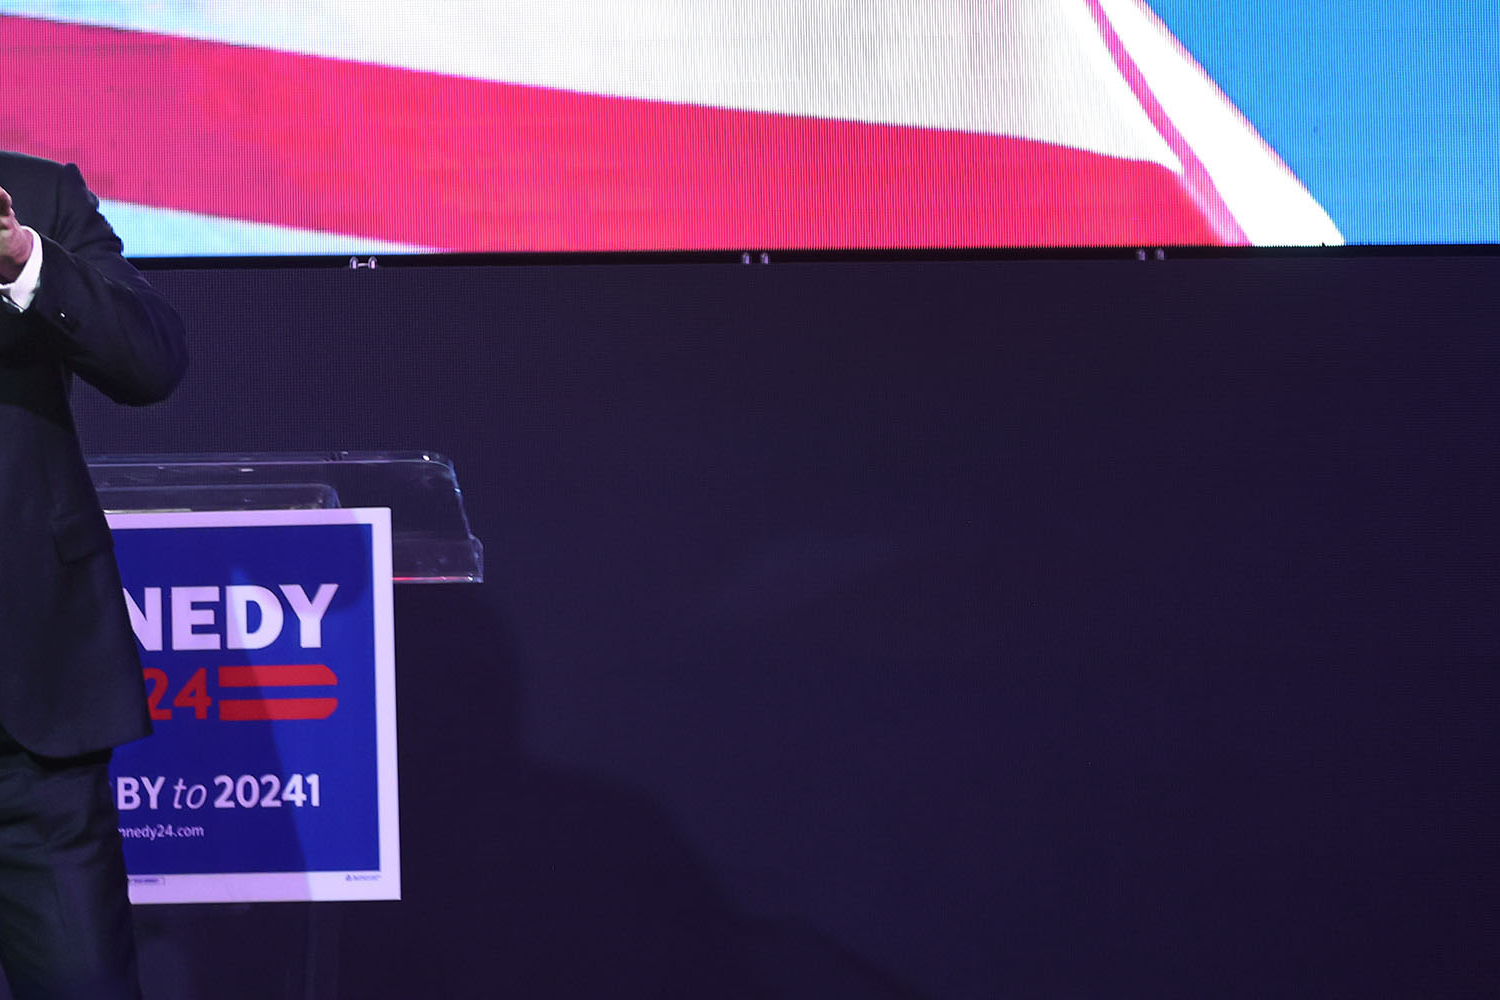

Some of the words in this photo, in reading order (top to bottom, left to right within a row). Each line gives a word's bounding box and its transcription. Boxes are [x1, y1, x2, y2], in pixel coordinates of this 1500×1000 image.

[143, 667, 212, 721] 24
[173, 777, 208, 810] to
[213, 773, 320, 808] 20241
